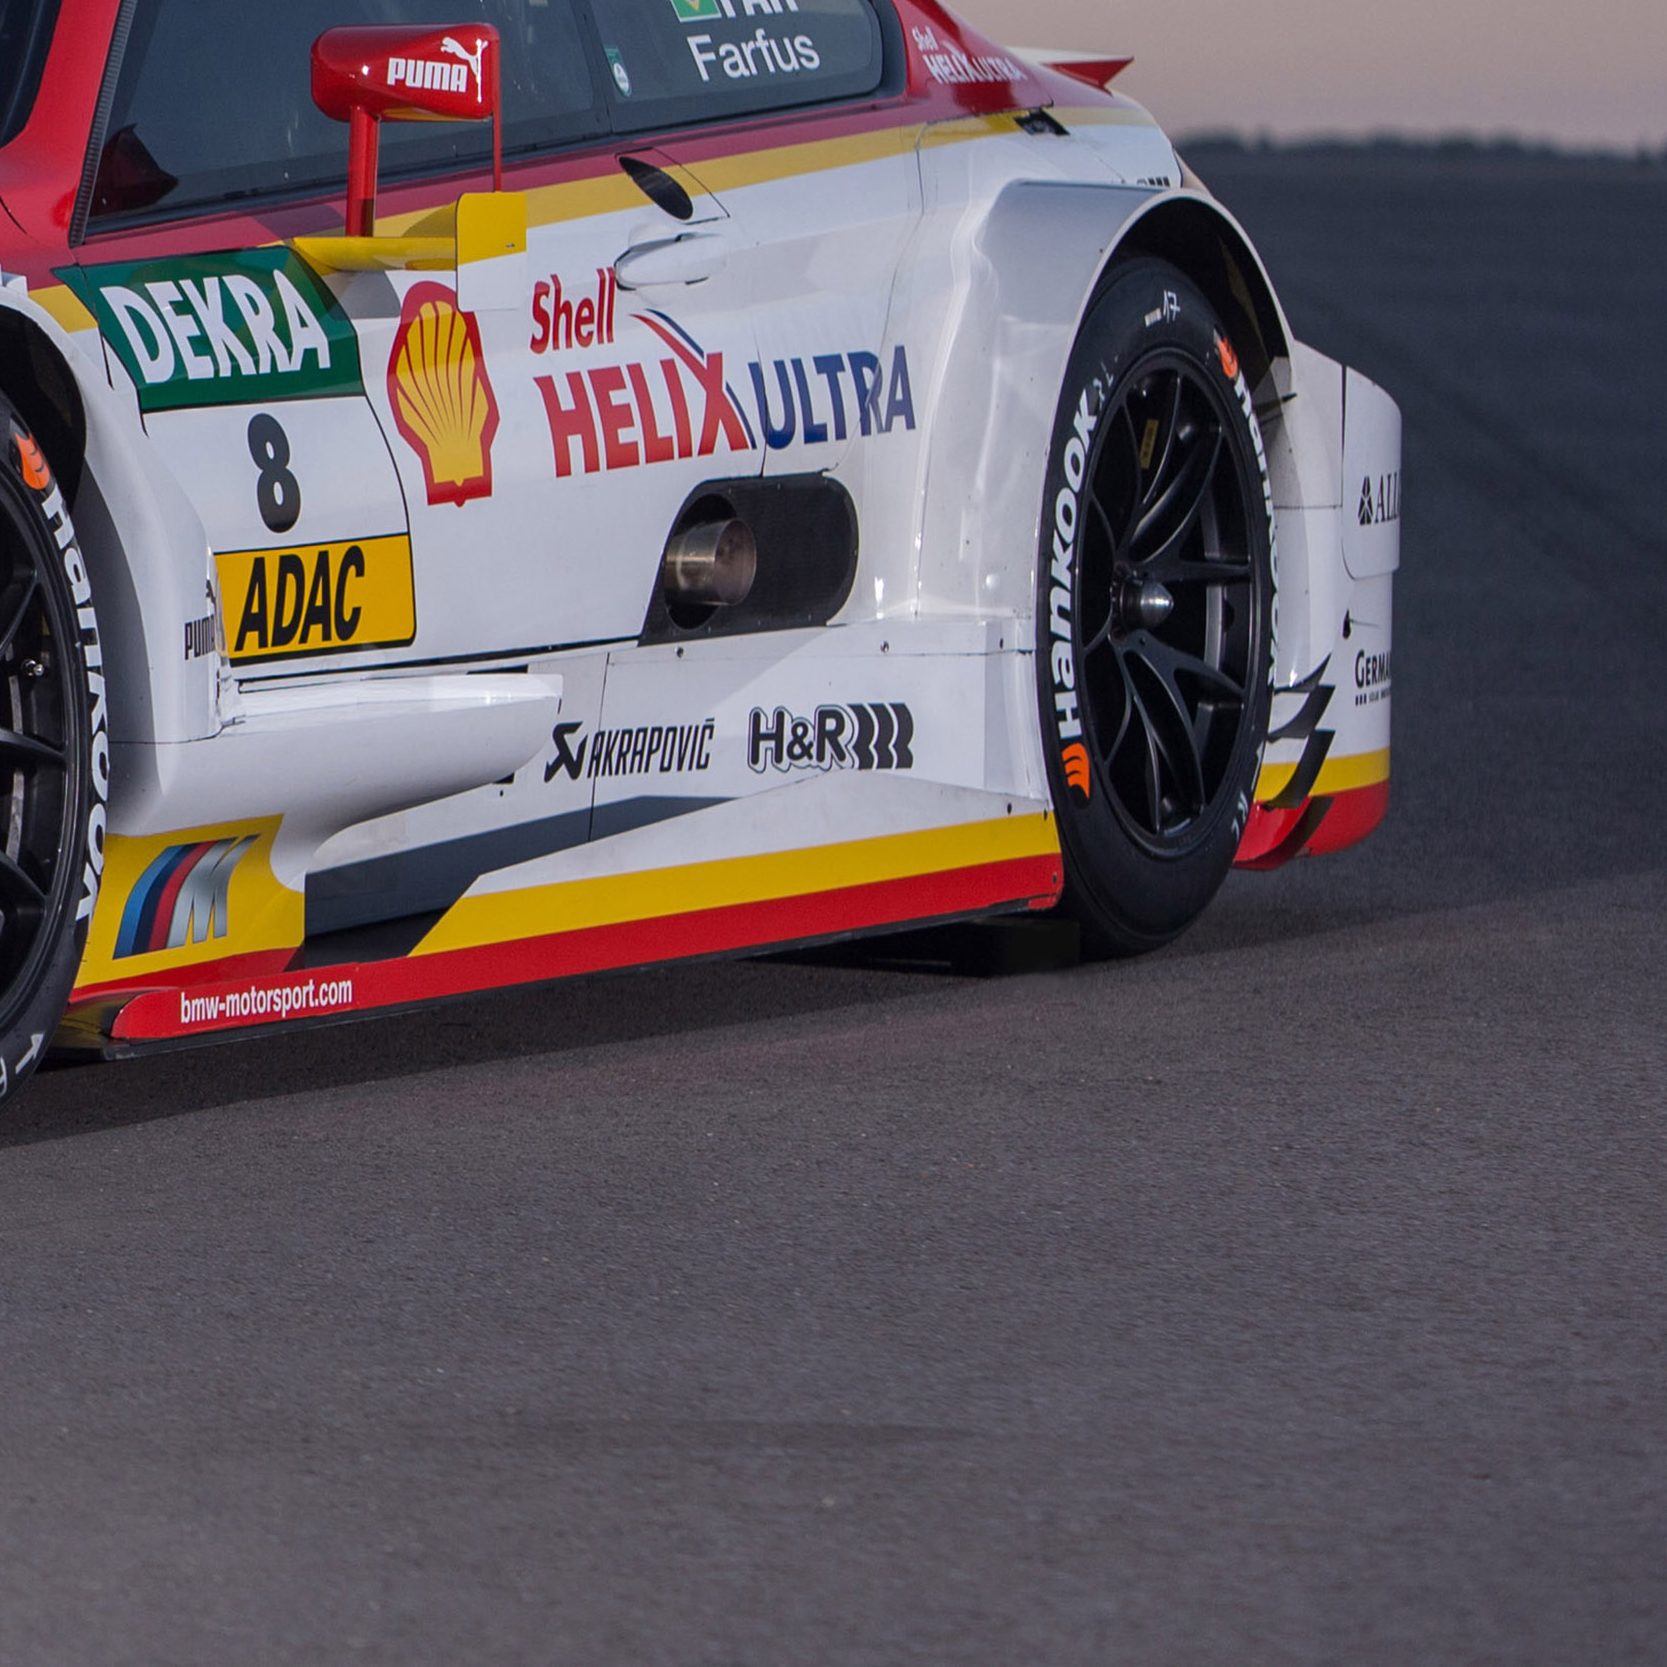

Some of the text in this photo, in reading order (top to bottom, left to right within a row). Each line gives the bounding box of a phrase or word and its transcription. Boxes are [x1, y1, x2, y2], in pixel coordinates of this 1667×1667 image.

[387, 56, 468, 93] PUMA
[686, 27, 821, 83] Farfus
[100, 269, 331, 384] DEKRA
[529, 266, 616, 355] Shell
[532, 344, 917, 479] HELIX ULTRA
[247, 412, 301, 534] 8
[234, 545, 365, 652] ADAC
[748, 704, 855, 774] H&R
[179, 978, 353, 1025] bmw-motorsport.com
